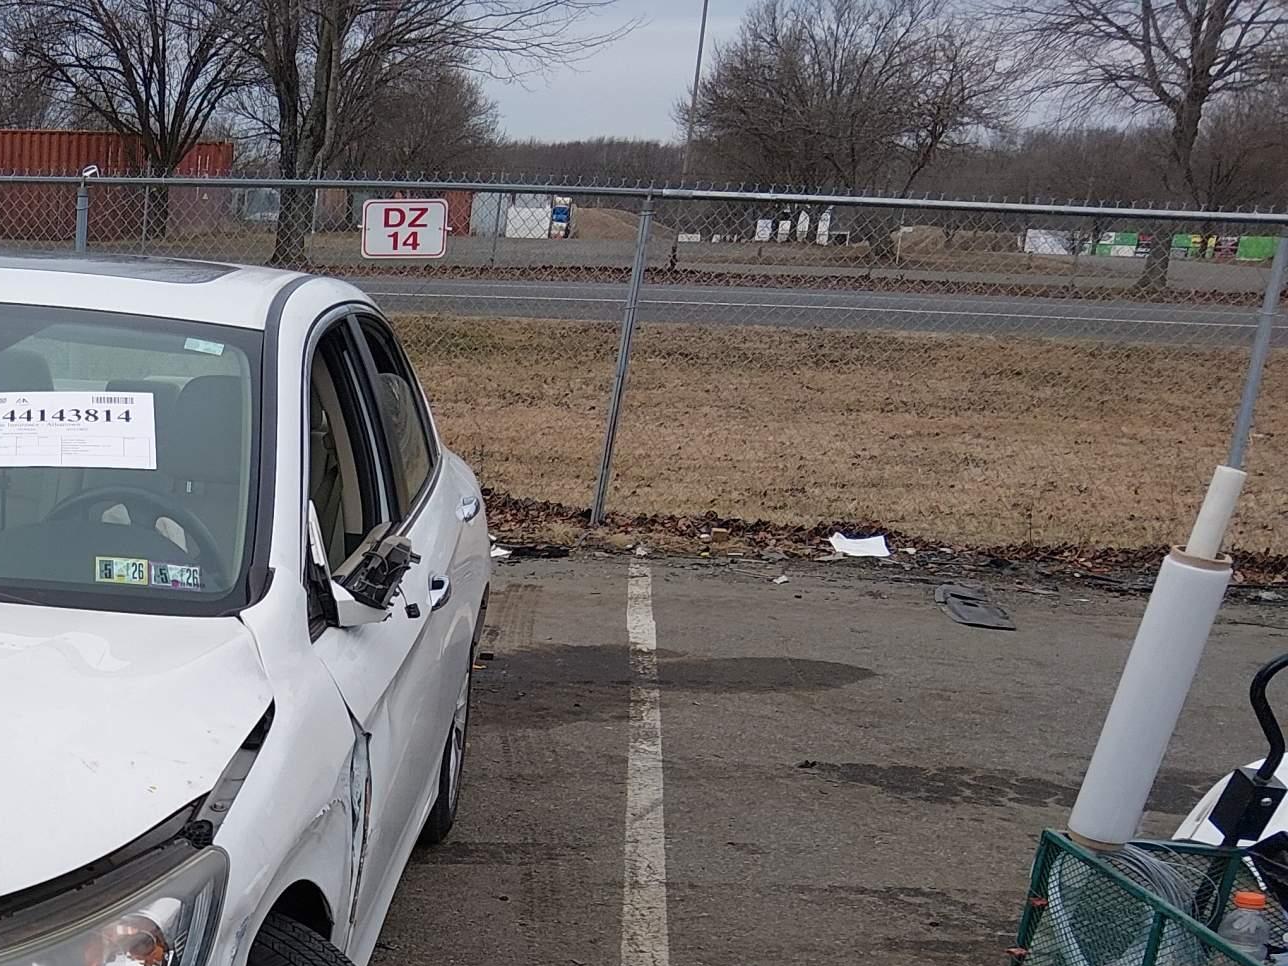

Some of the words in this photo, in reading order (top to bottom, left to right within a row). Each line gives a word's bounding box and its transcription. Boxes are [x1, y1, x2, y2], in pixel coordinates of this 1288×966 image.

[383, 207, 429, 228] DZ
[386, 231, 420, 250] 14
[2, 408, 132, 423] 44143814
[103, 563, 112, 579] 5
[131, 562, 144, 579] 26
[185, 568, 198, 587] 26
